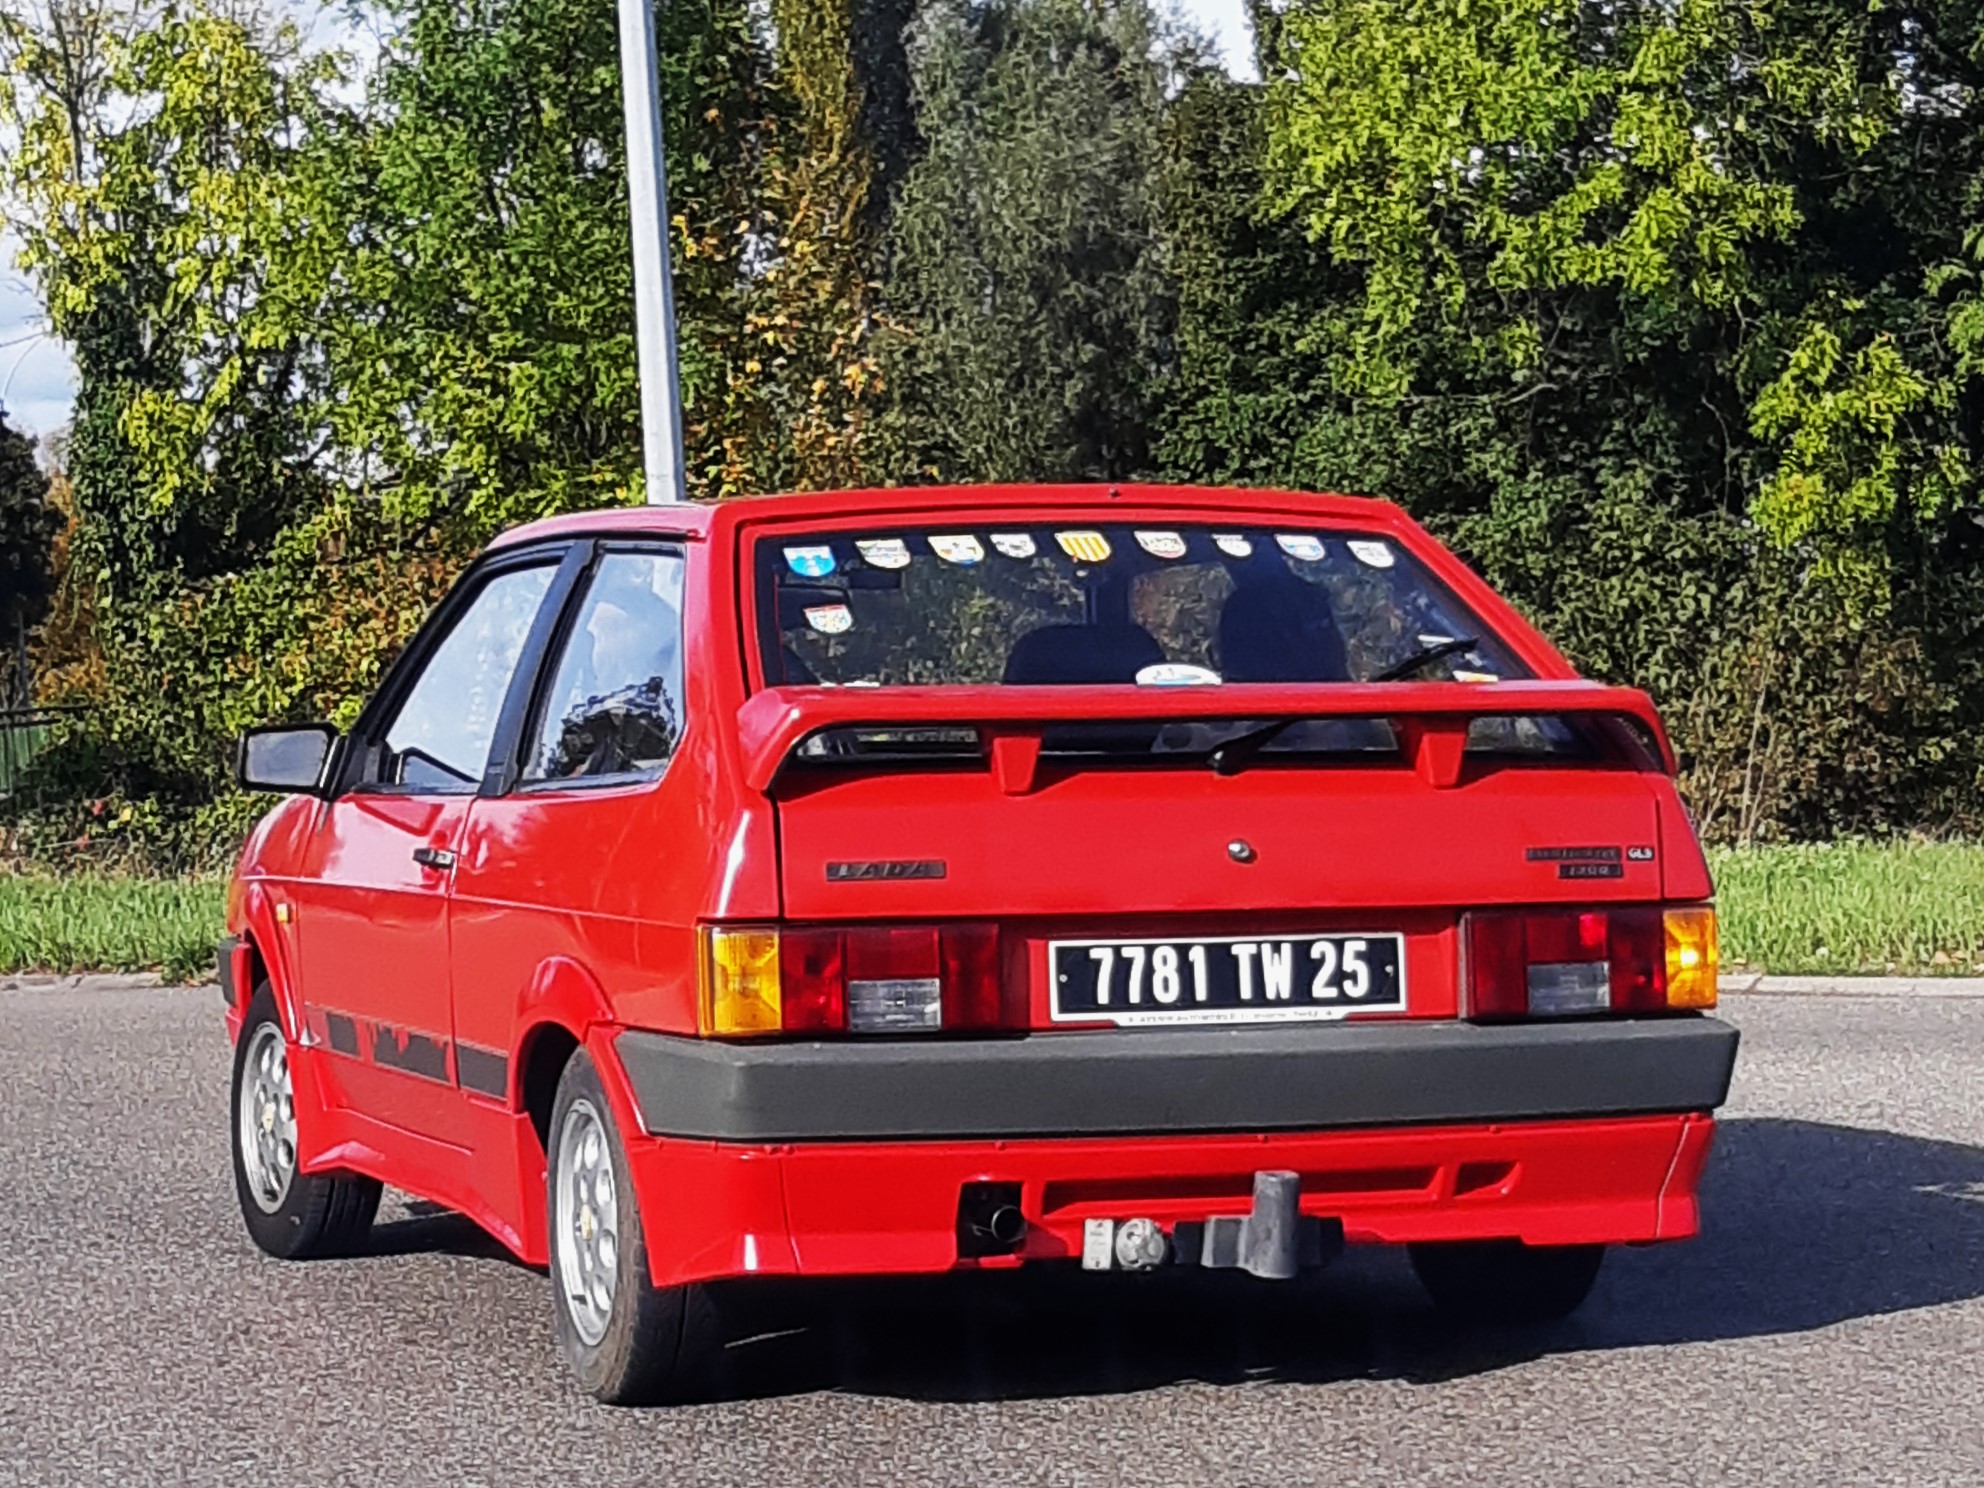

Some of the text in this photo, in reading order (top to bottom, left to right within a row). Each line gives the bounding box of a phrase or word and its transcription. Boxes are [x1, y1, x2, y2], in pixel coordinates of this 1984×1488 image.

[837, 861, 927, 877] LADA
[1089, 940, 1370, 1005] 7781 TW 25
